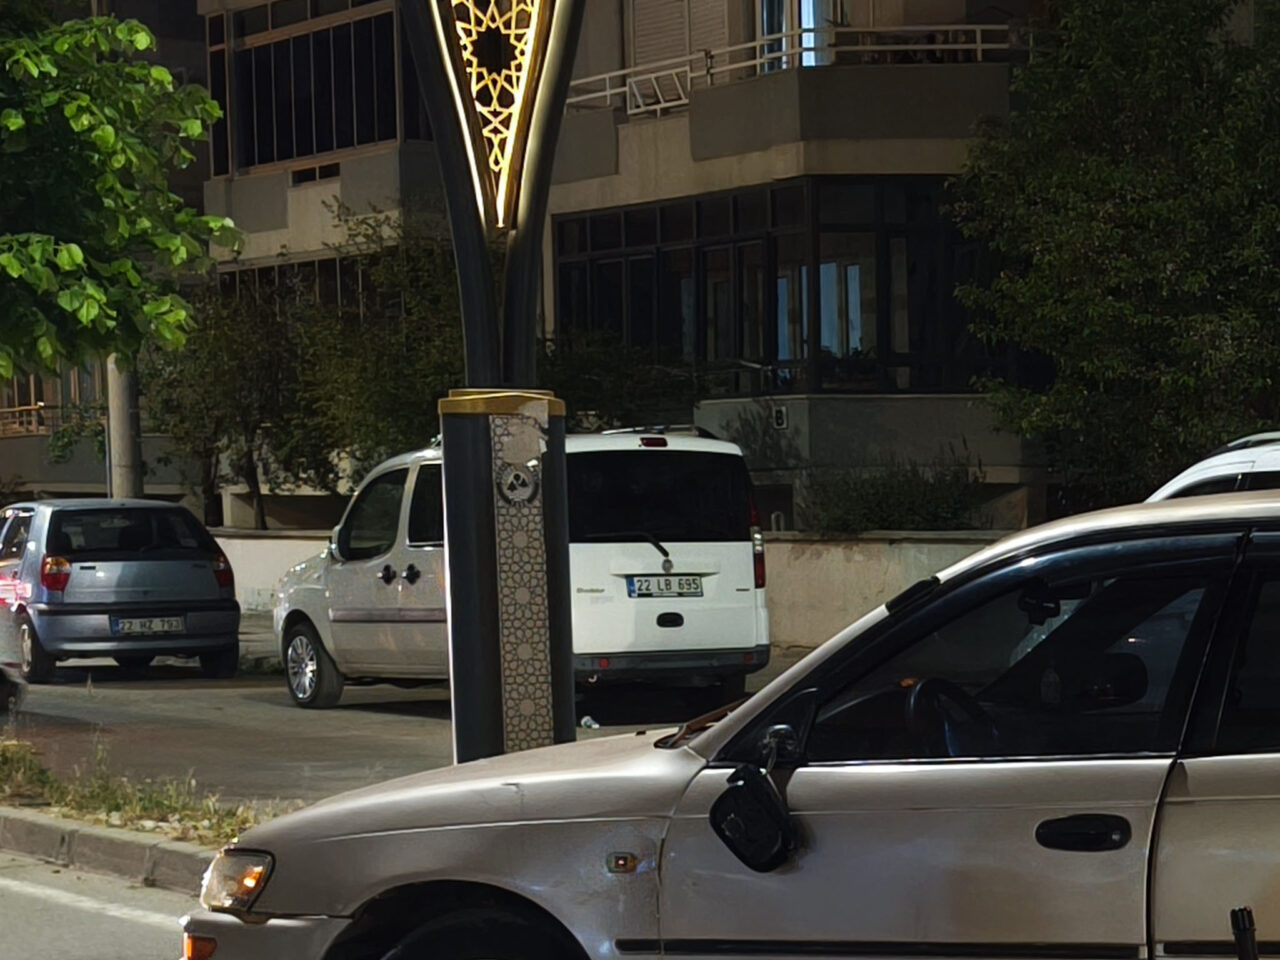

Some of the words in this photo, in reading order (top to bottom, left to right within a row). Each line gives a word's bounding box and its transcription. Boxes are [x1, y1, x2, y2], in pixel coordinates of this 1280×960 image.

[637, 579, 651, 592] 22
[657, 579, 672, 591] LB
[678, 578, 700, 591] 695
[120, 620, 133, 631] 22
